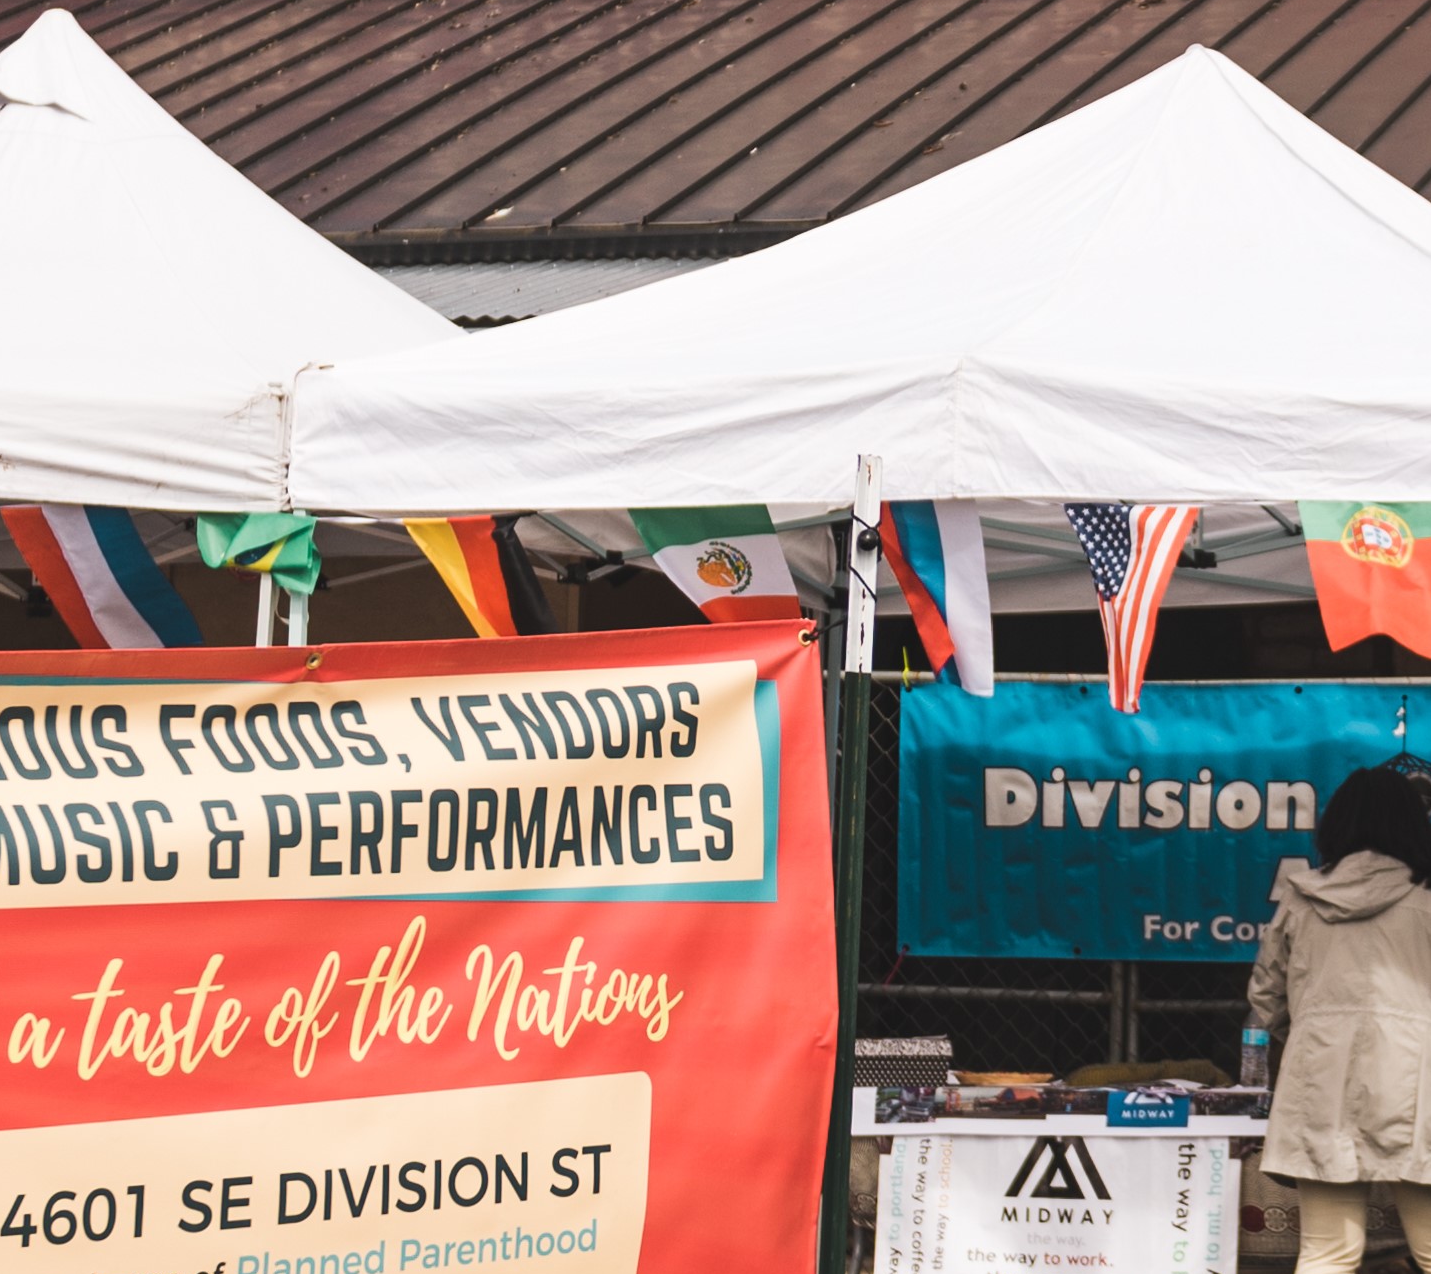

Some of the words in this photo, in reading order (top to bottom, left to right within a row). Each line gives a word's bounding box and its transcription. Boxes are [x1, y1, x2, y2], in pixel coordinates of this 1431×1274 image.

[158, 699, 412, 776] FOODS,
[408, 681, 701, 764] VENDORS
[983, 766, 1316, 829] Division
[208, 804, 241, 880] &
[267, 782, 735, 879] PERFORMANCES
[1144, 915, 1200, 941] For
[7, 1011, 62, 1067] a
[71, 953, 247, 1080] taste
[264, 949, 343, 1078] of
[347, 915, 452, 1063] the
[465, 936, 683, 1061] Nations
[1122, 1110, 1174, 1119] MIDWAY
[918, 1138, 932, 1165] the
[1177, 1142, 1197, 1181] the
[177, 1176, 254, 1232] SE
[276, 1151, 530, 1225] DIVISION
[549, 1143, 613, 1197] ST
[911, 1173, 926, 1203] way
[938, 1194, 949, 1208] to
[1171, 1188, 1191, 1232] way
[913, 1209, 926, 1225] to
[937, 1213, 950, 1241] way
[1001, 1206, 1114, 1225] MIDWAY
[889, 1222, 900, 1241] to
[1027, 1232, 1051, 1245] the
[398, 1219, 599, 1274] Parenthood
[933, 1244, 944, 1270] the
[967, 1248, 996, 1263] the
[1003, 1253, 1037, 1266] way
[1044, 1253, 1061, 1265] to
[1067, 1253, 1114, 1267] work.
[1173, 1240, 1189, 1262] to
[1205, 1243, 1219, 1262] to
